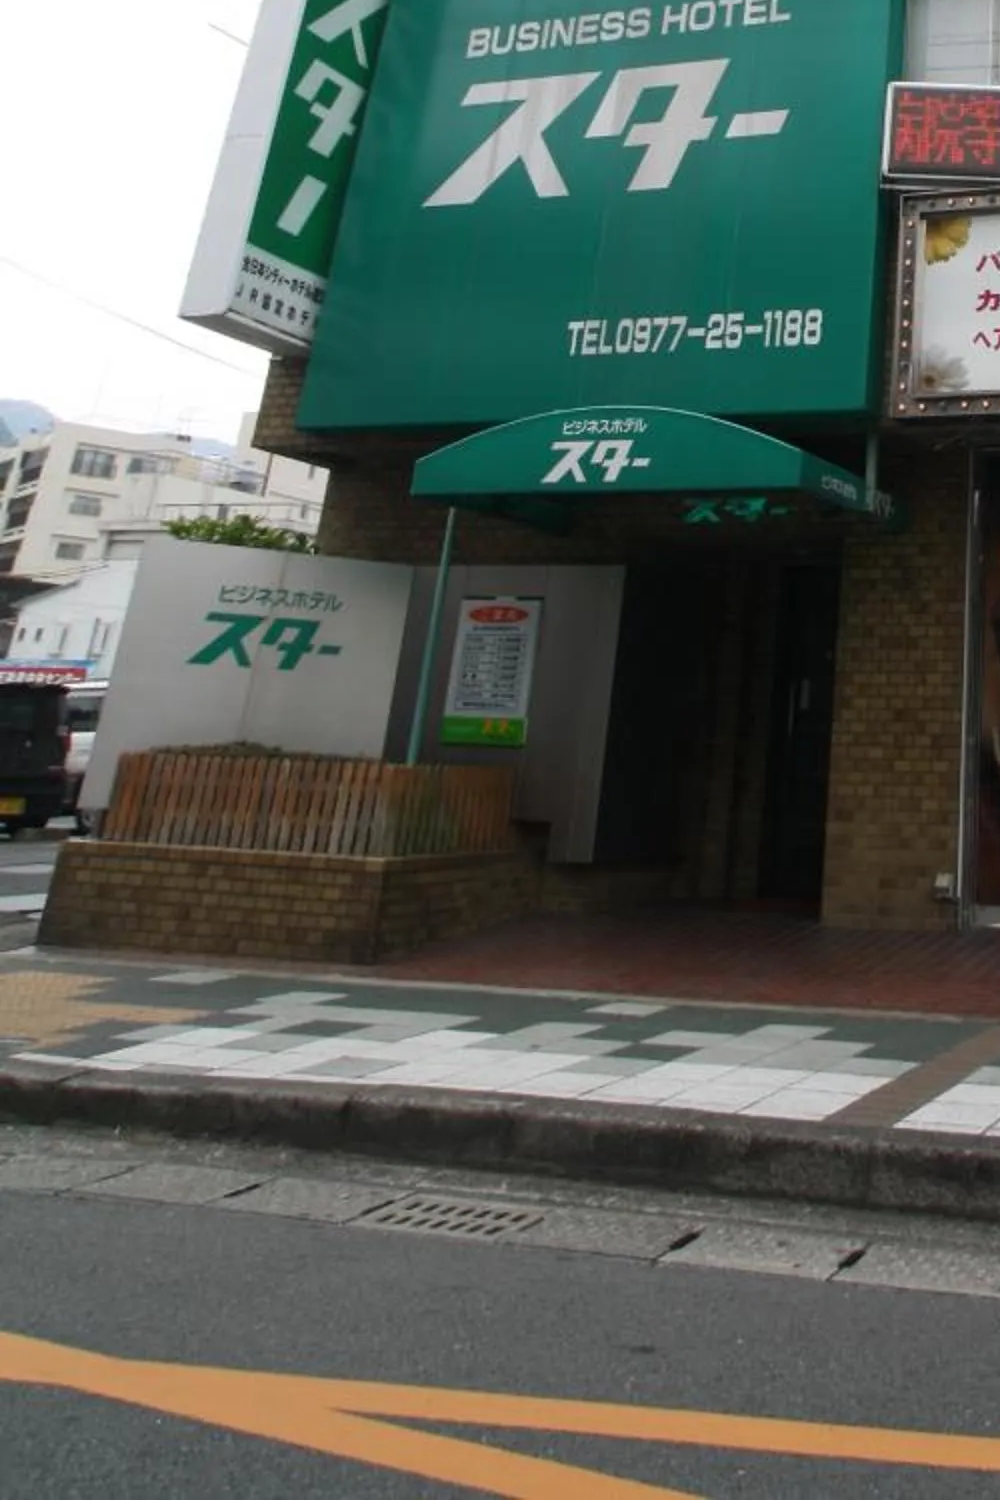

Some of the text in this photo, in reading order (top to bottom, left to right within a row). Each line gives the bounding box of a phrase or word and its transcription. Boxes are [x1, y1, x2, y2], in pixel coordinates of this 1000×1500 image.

[466, 7, 651, 58] BUSINESS
[421, 57, 789, 208] スター
[562, 418, 648, 435] ビジネスホテル
[540, 439, 650, 484] スター
[219, 585, 344, 612] ビジネスホテル
[186, 611, 342, 670] スター
